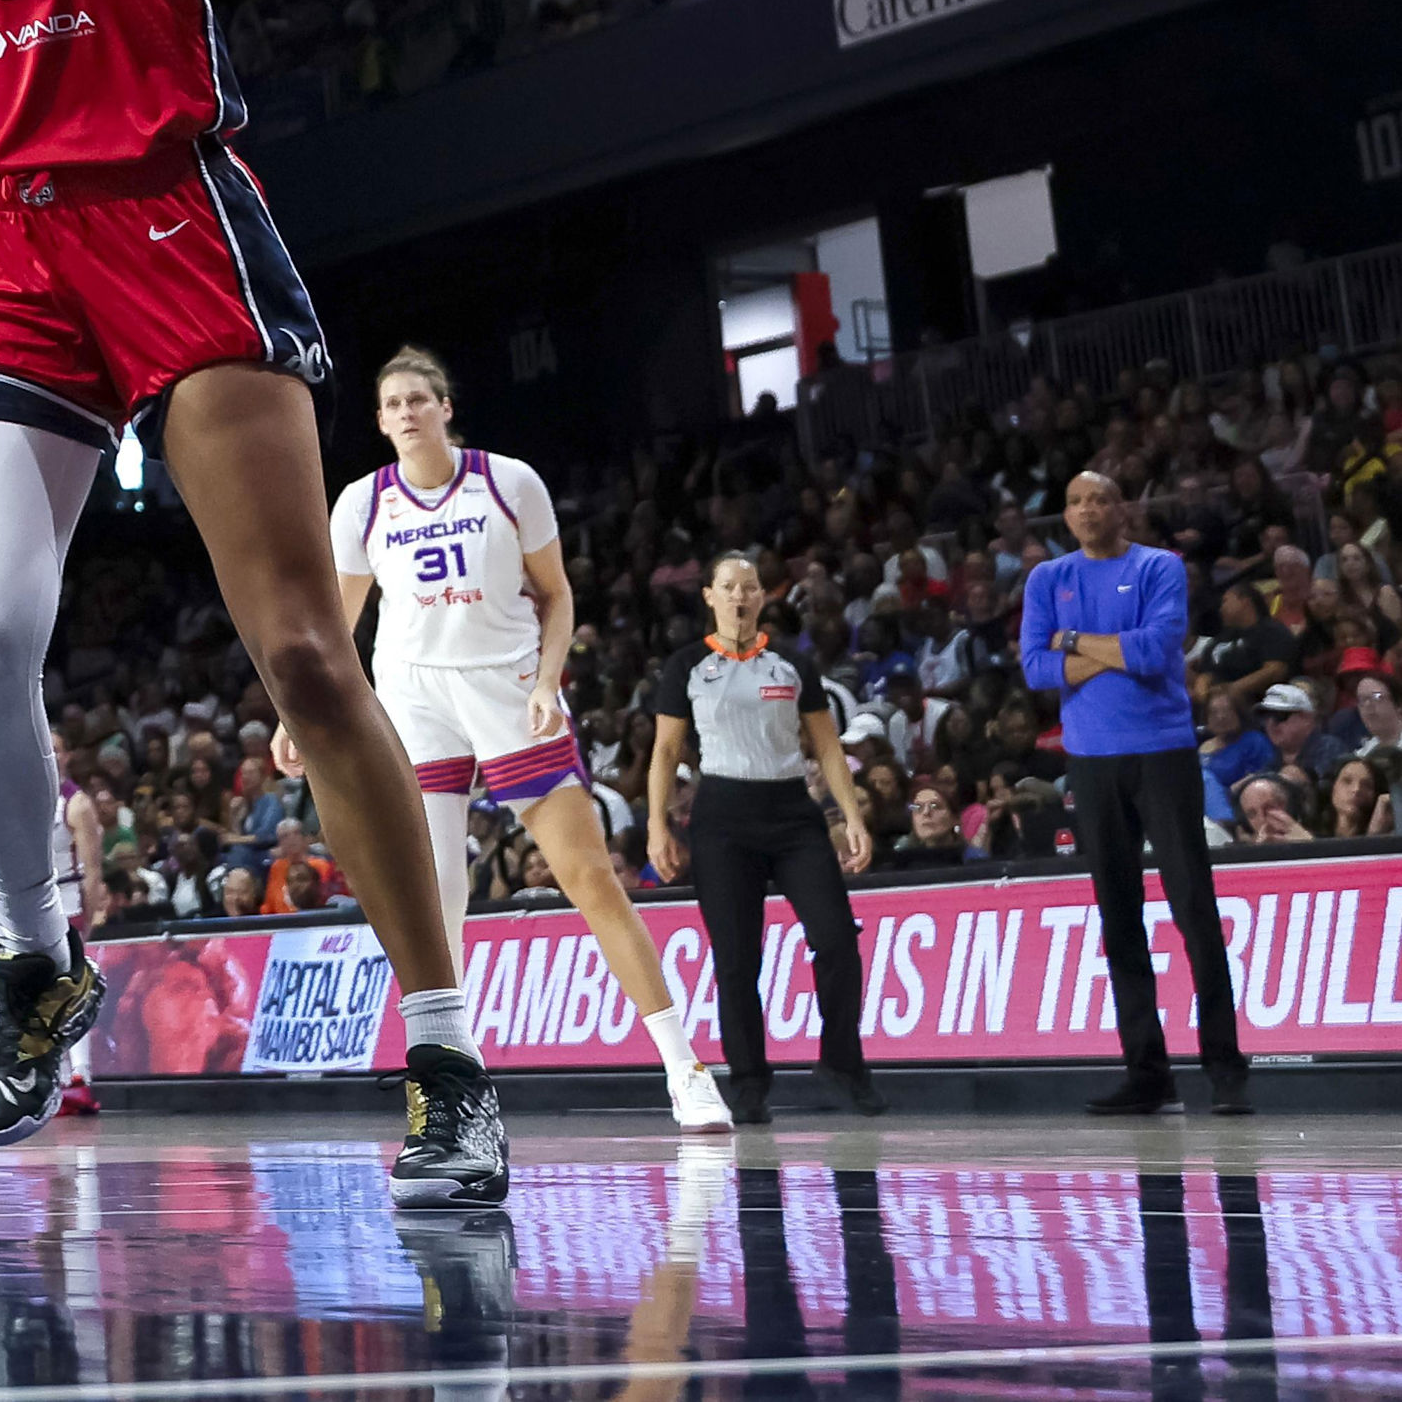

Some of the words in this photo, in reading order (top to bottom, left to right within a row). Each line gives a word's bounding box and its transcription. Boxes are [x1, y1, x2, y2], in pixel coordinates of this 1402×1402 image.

[5, 10, 97, 46] VANDA
[385, 515, 488, 549] MERCURY
[413, 542, 468, 583] 31
[859, 913, 937, 1038] IS
[937, 908, 1025, 1036] IN
[254, 1018, 323, 1063] MAMBO
[321, 1013, 374, 1062] SAUCE
